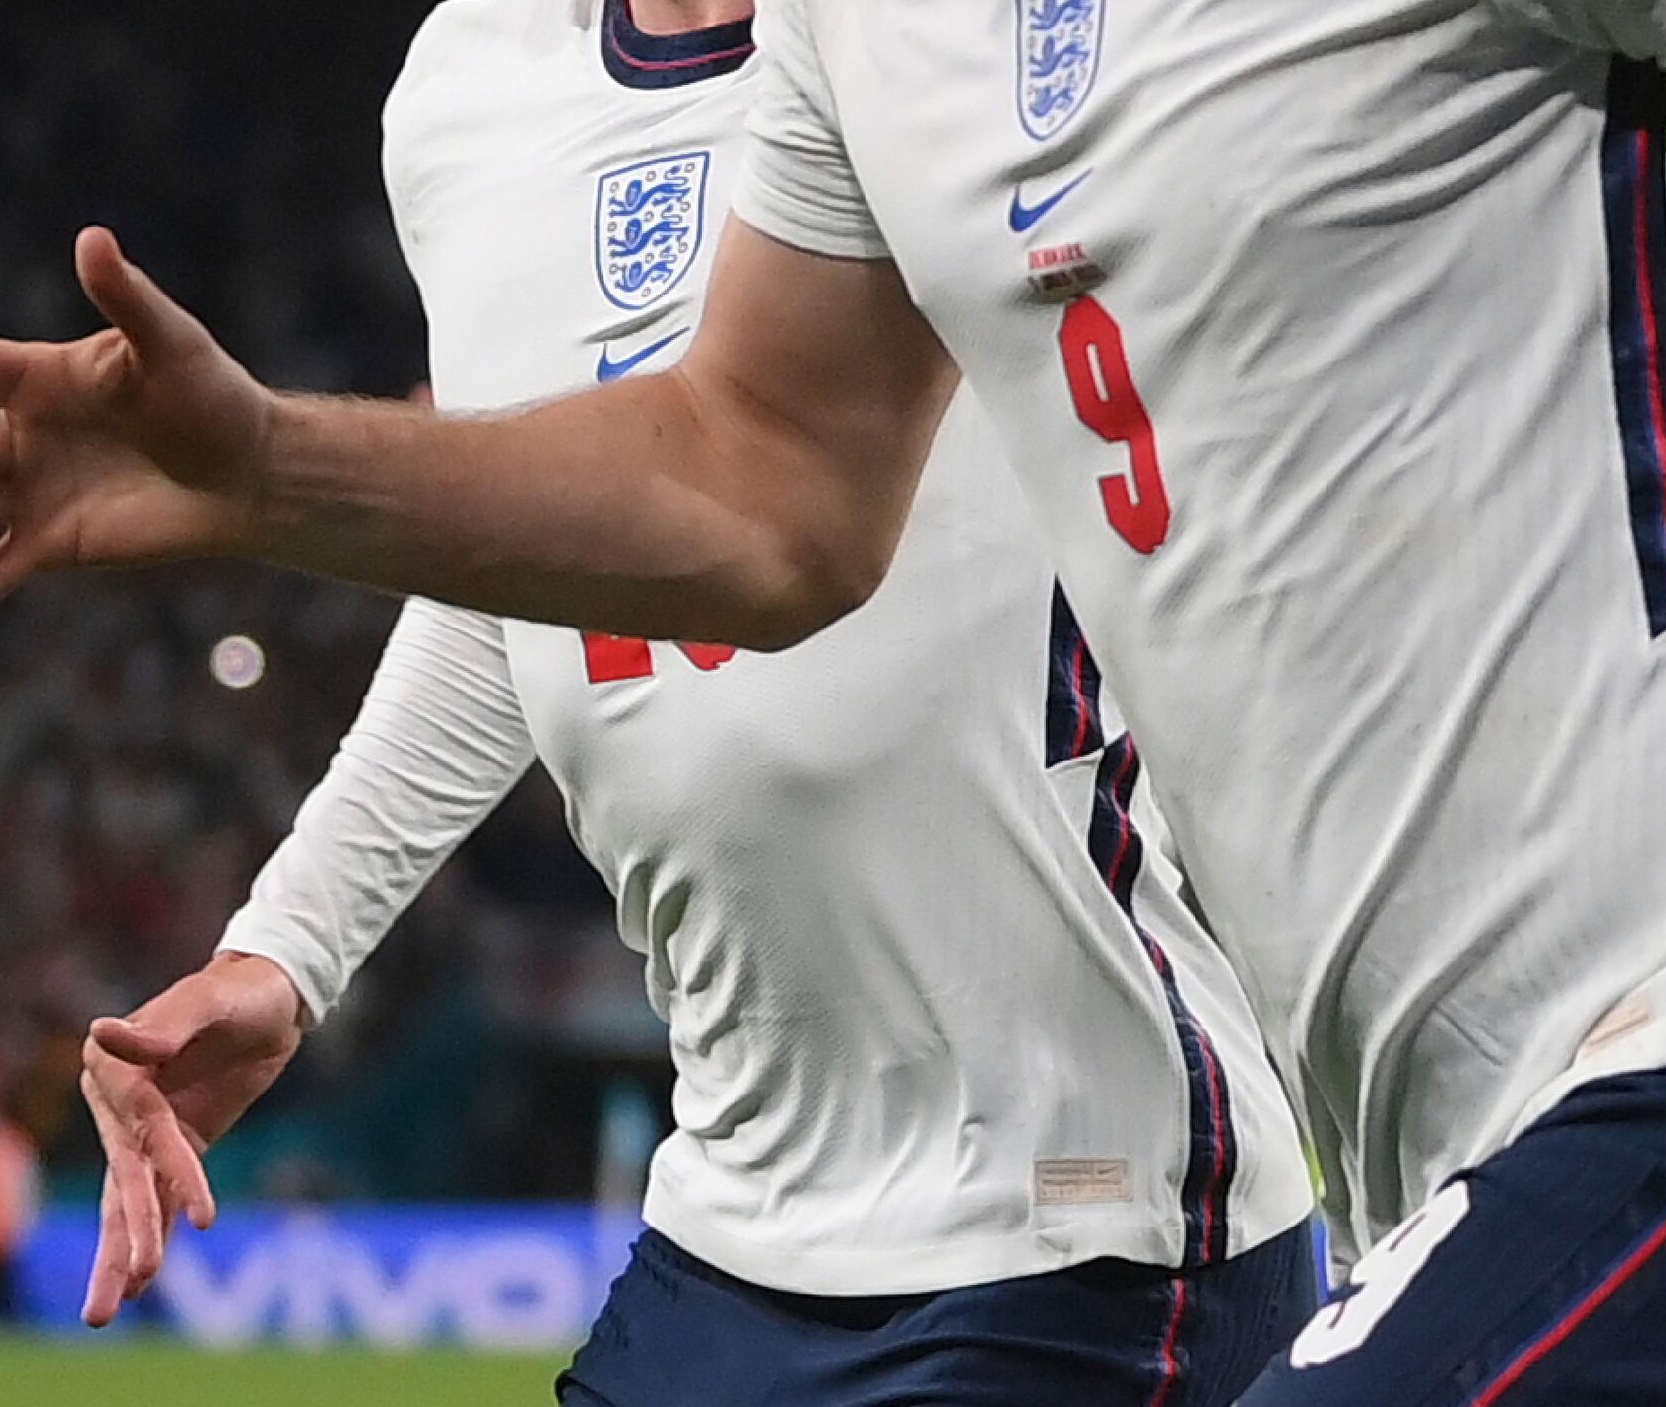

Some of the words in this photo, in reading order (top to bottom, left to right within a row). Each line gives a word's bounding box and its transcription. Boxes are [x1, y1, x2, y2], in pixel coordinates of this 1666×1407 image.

[1059, 294, 1171, 555] 9
[159, 1212, 587, 1351] vivo
[1289, 1180, 1470, 1368] 9
